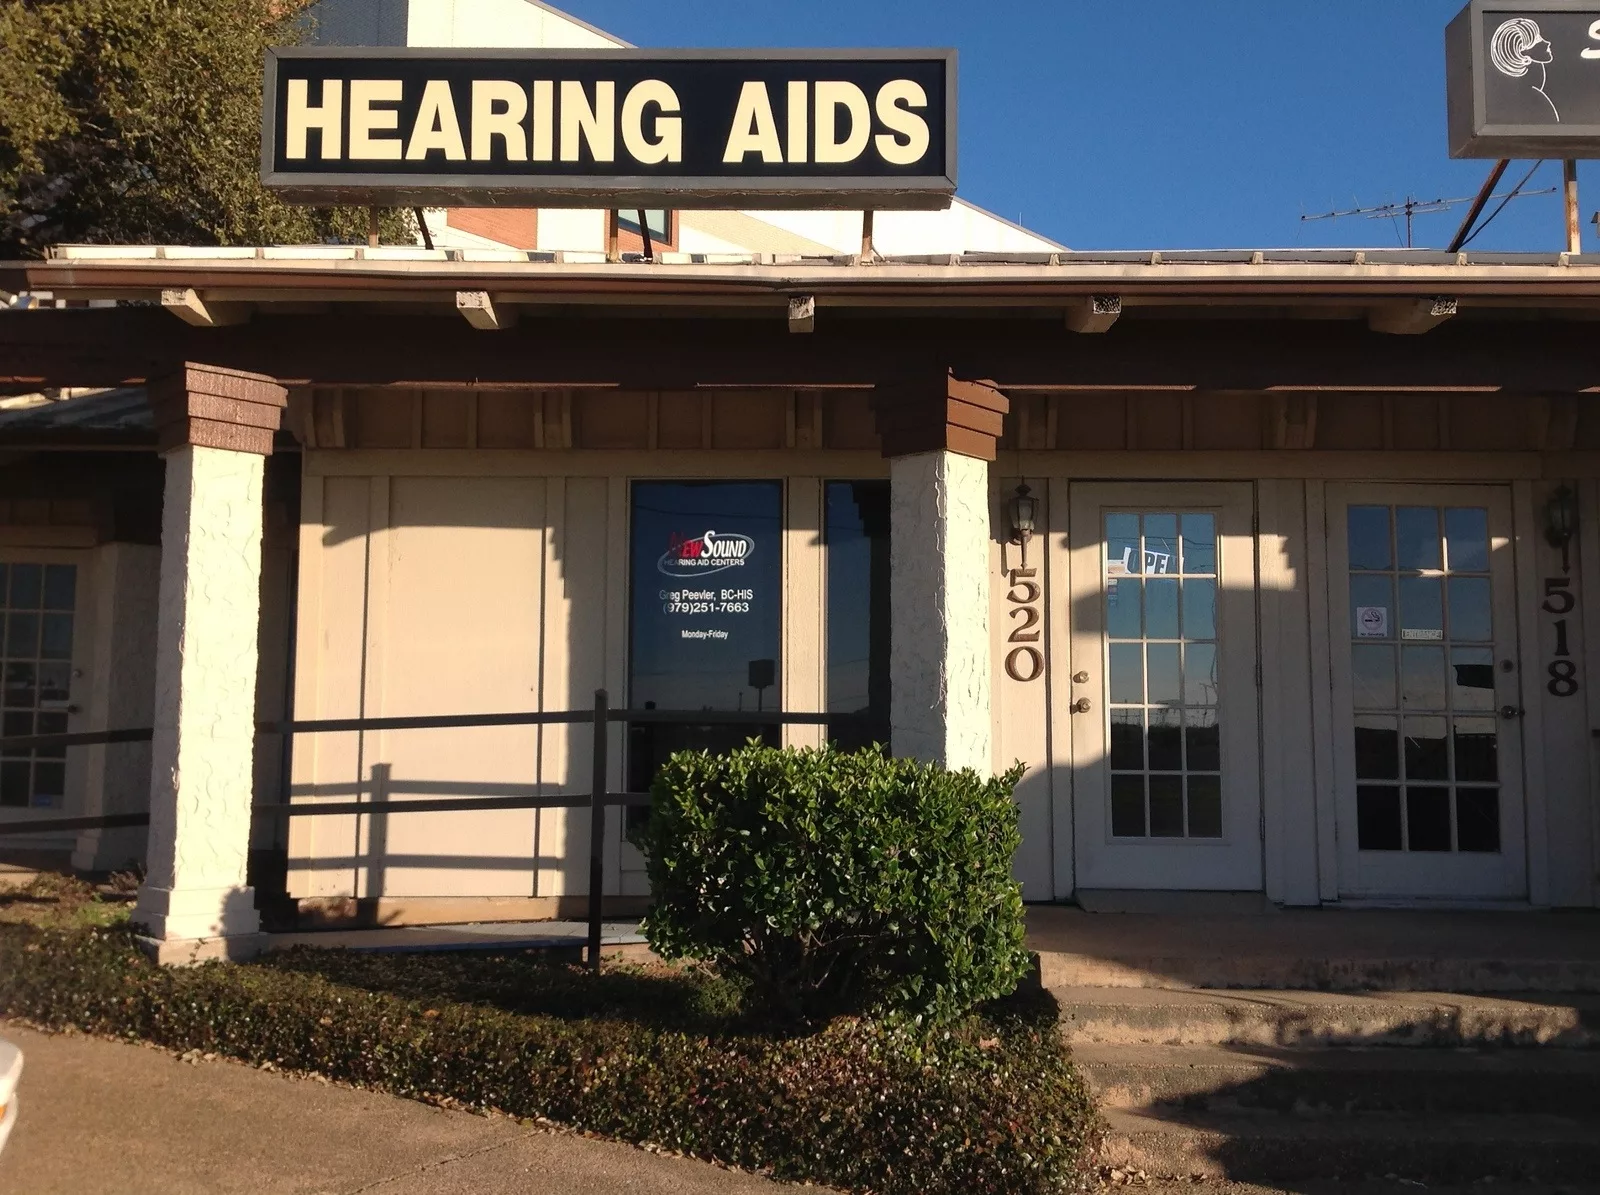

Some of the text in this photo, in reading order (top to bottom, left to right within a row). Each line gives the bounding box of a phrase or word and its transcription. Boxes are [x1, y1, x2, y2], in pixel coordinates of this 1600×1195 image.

[286, 78, 930, 165] HEARING AIDS
[697, 558, 710, 566] AID
[711, 558, 745, 566] CENTERS
[1126, 547, 1180, 575] OPE
[659, 589, 680, 602] Greg
[721, 589, 754, 600] BC-HIS
[663, 602, 750, 614] (979)251-7663
[1005, 567, 1045, 682] 520
[681, 630, 729, 640] Monday-Friday
[1542, 577, 1579, 697] 518
